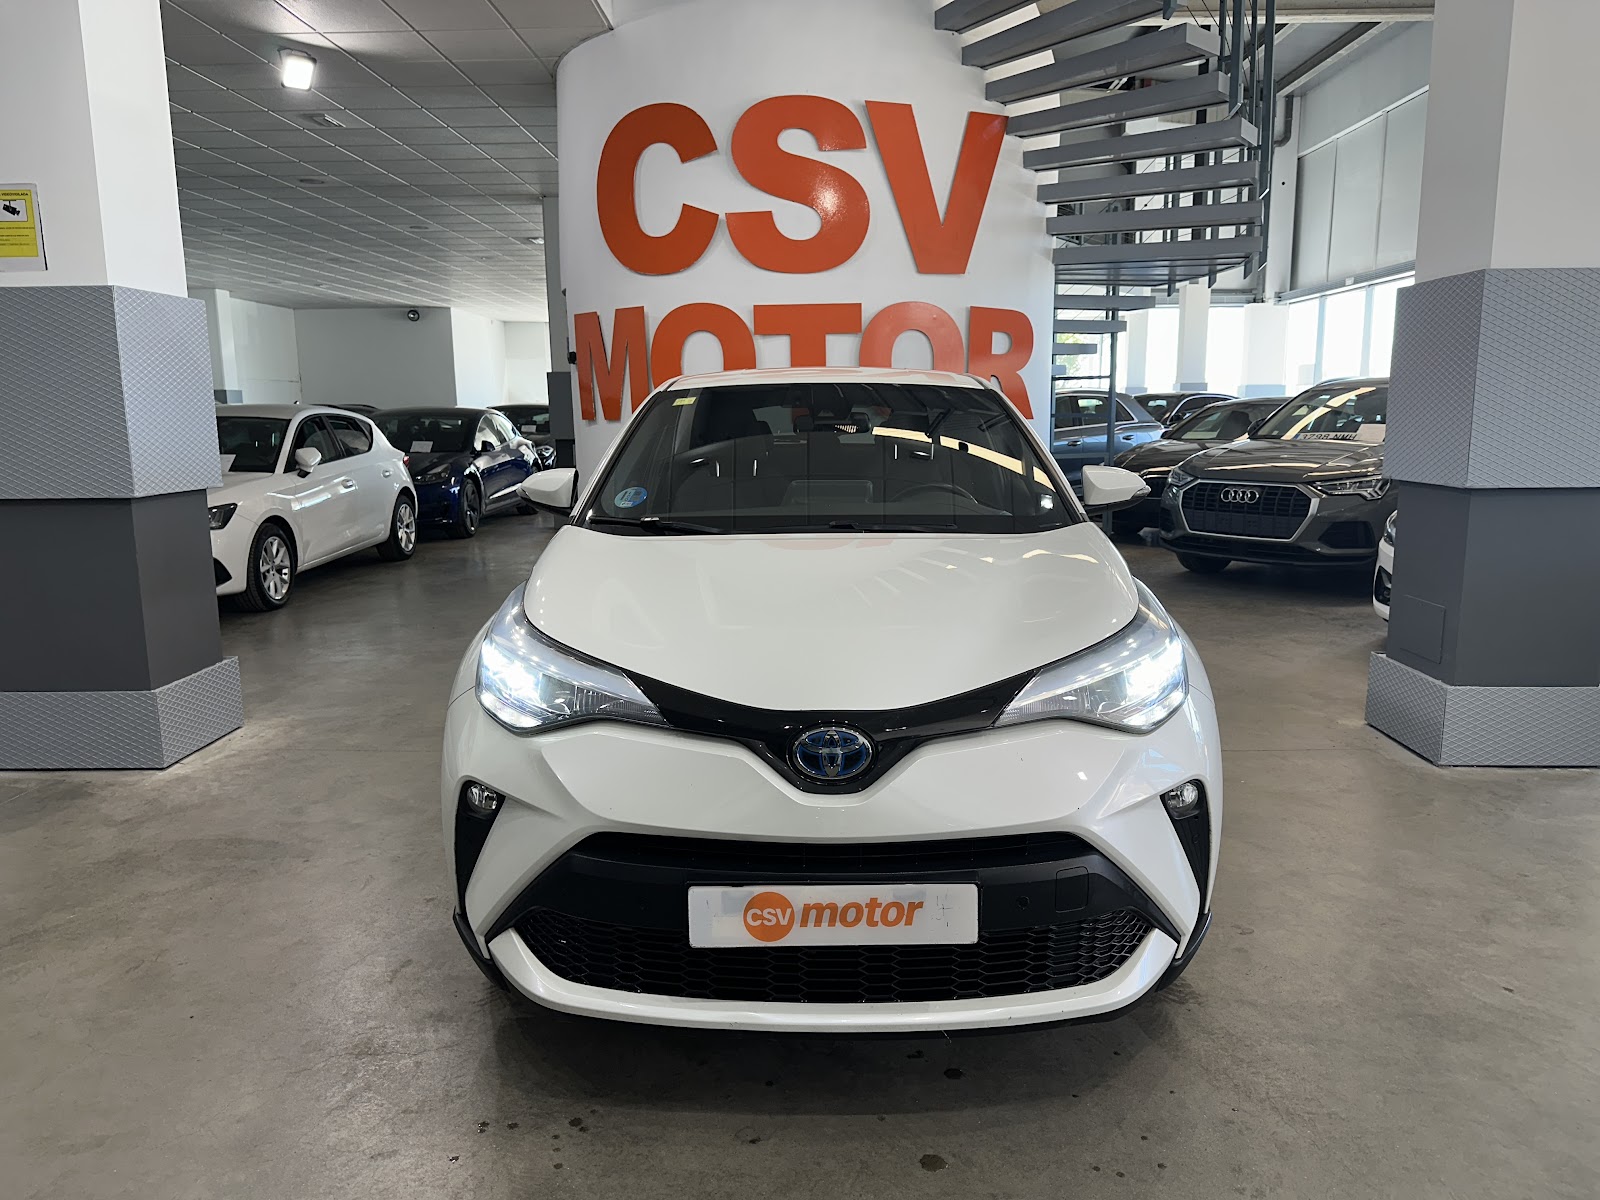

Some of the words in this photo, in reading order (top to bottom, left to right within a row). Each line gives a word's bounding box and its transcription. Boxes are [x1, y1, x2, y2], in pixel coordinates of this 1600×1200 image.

[597, 95, 1009, 275] CSV
[574, 301, 1034, 421] MOTOR
[746, 907, 792, 926] CSV
[799, 897, 925, 928] motor
